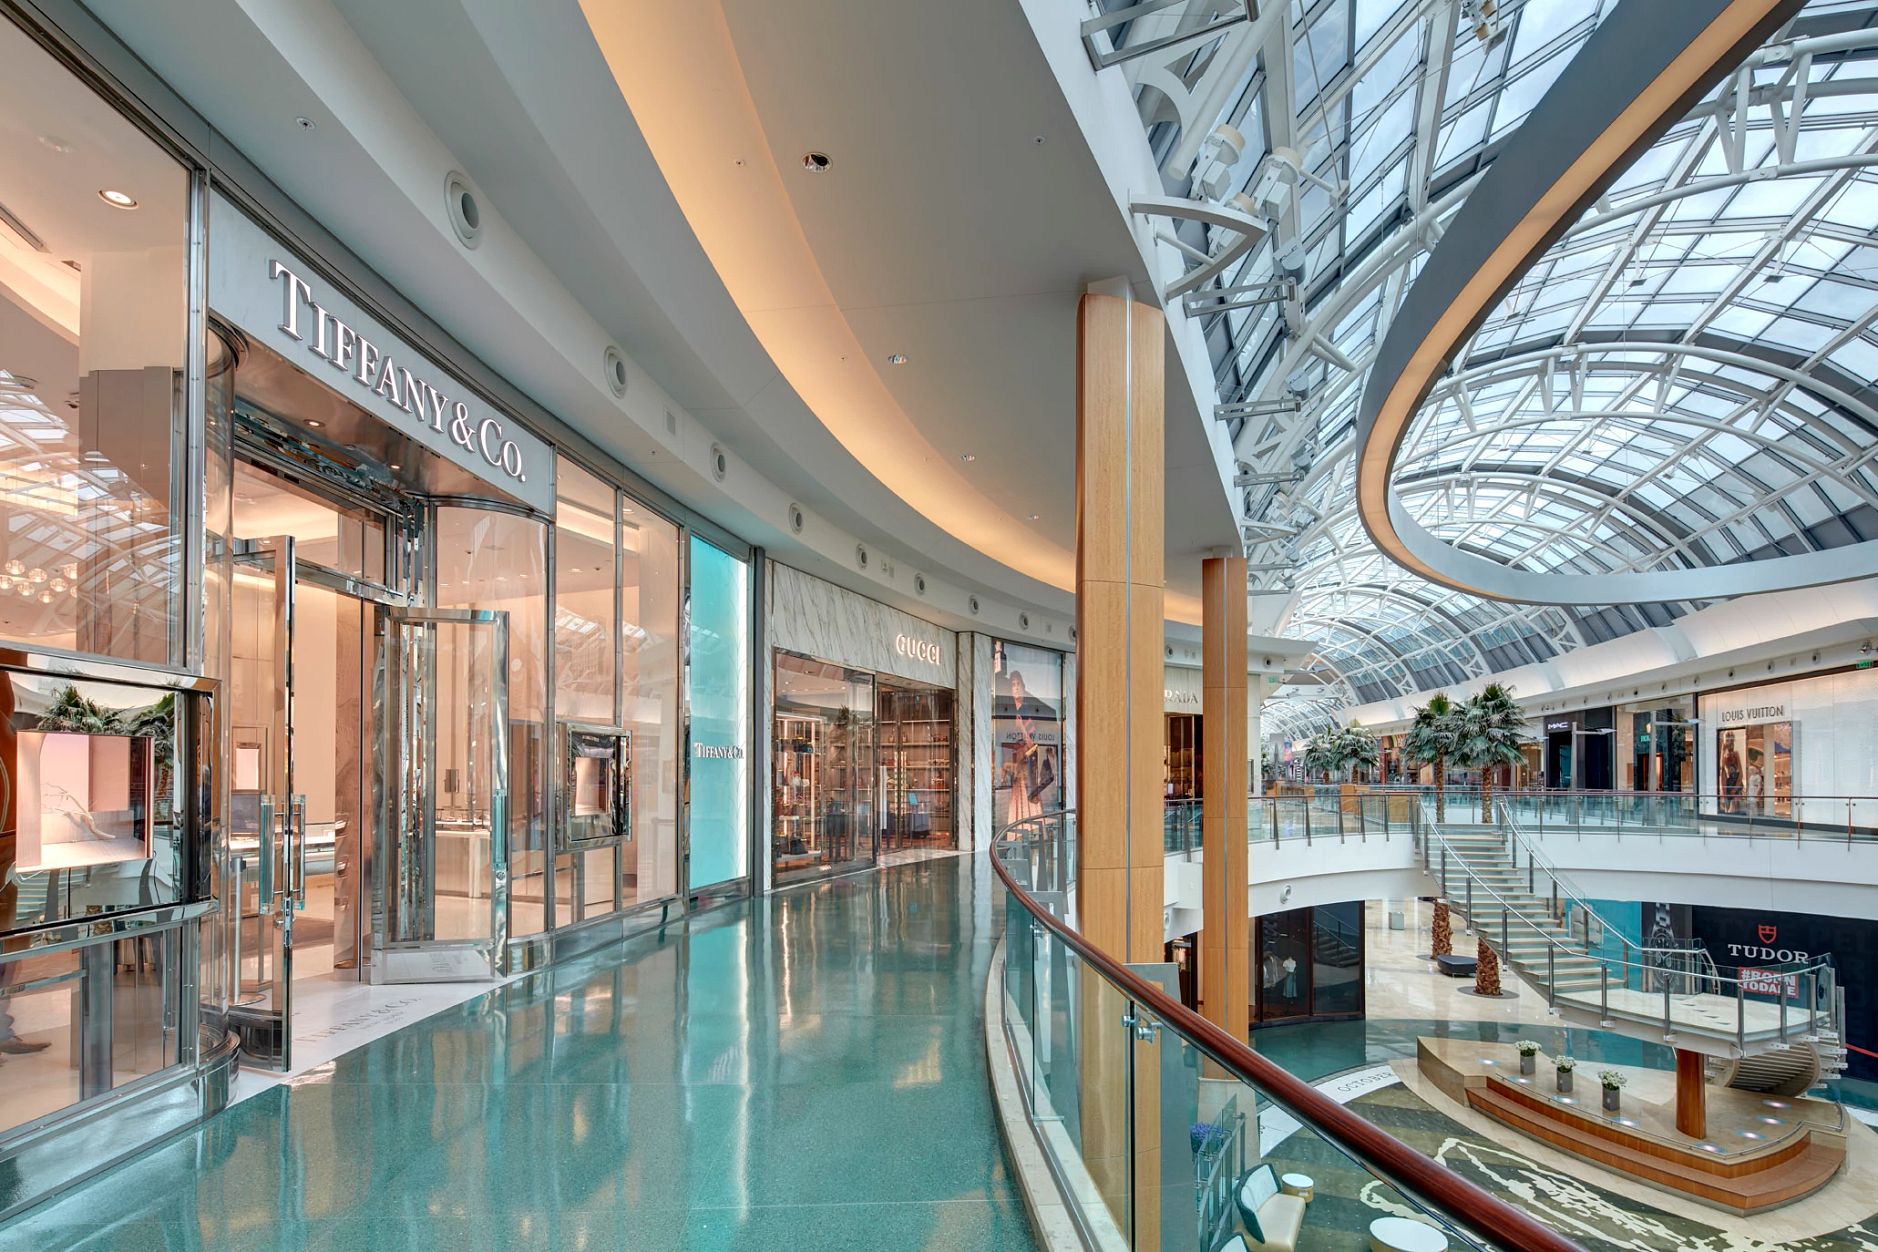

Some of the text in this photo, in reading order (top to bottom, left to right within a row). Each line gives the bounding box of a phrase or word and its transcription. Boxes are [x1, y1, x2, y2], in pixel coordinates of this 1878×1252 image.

[896, 633, 941, 666] GUCCI
[1164, 689, 1199, 704] RADA
[1721, 704, 1785, 722] LOUIS VUITTON
[1727, 943, 1809, 965] TUDOR
[1742, 980, 1797, 996] TODAE
